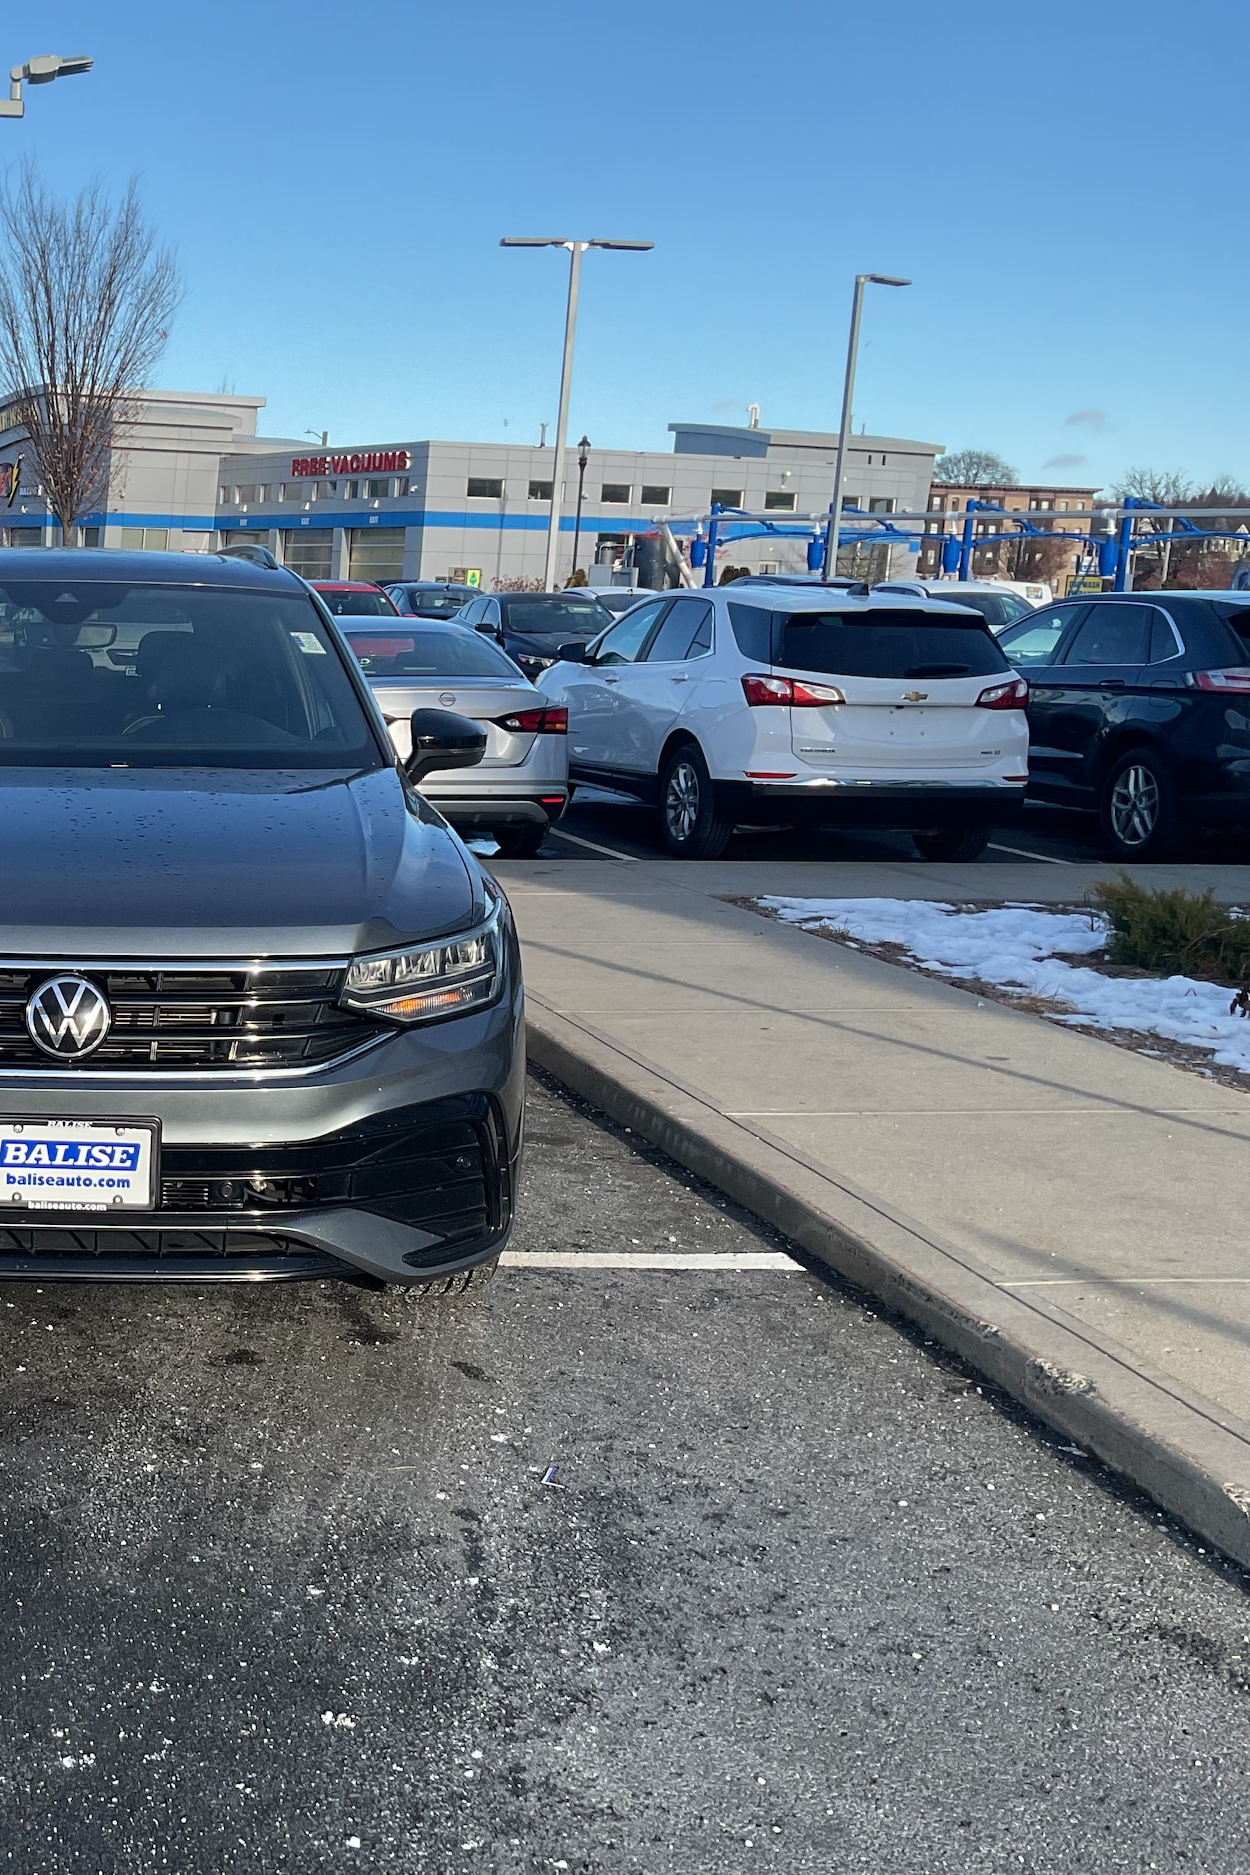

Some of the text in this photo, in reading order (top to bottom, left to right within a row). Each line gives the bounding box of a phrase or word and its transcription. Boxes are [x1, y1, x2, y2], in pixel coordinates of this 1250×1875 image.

[291, 451, 411, 477] FREE VACUUMS
[3, 1142, 135, 1168] BALISE
[6, 1173, 131, 1189] baliseauto.com
[27, 1200, 107, 1212] baliseauto.com
